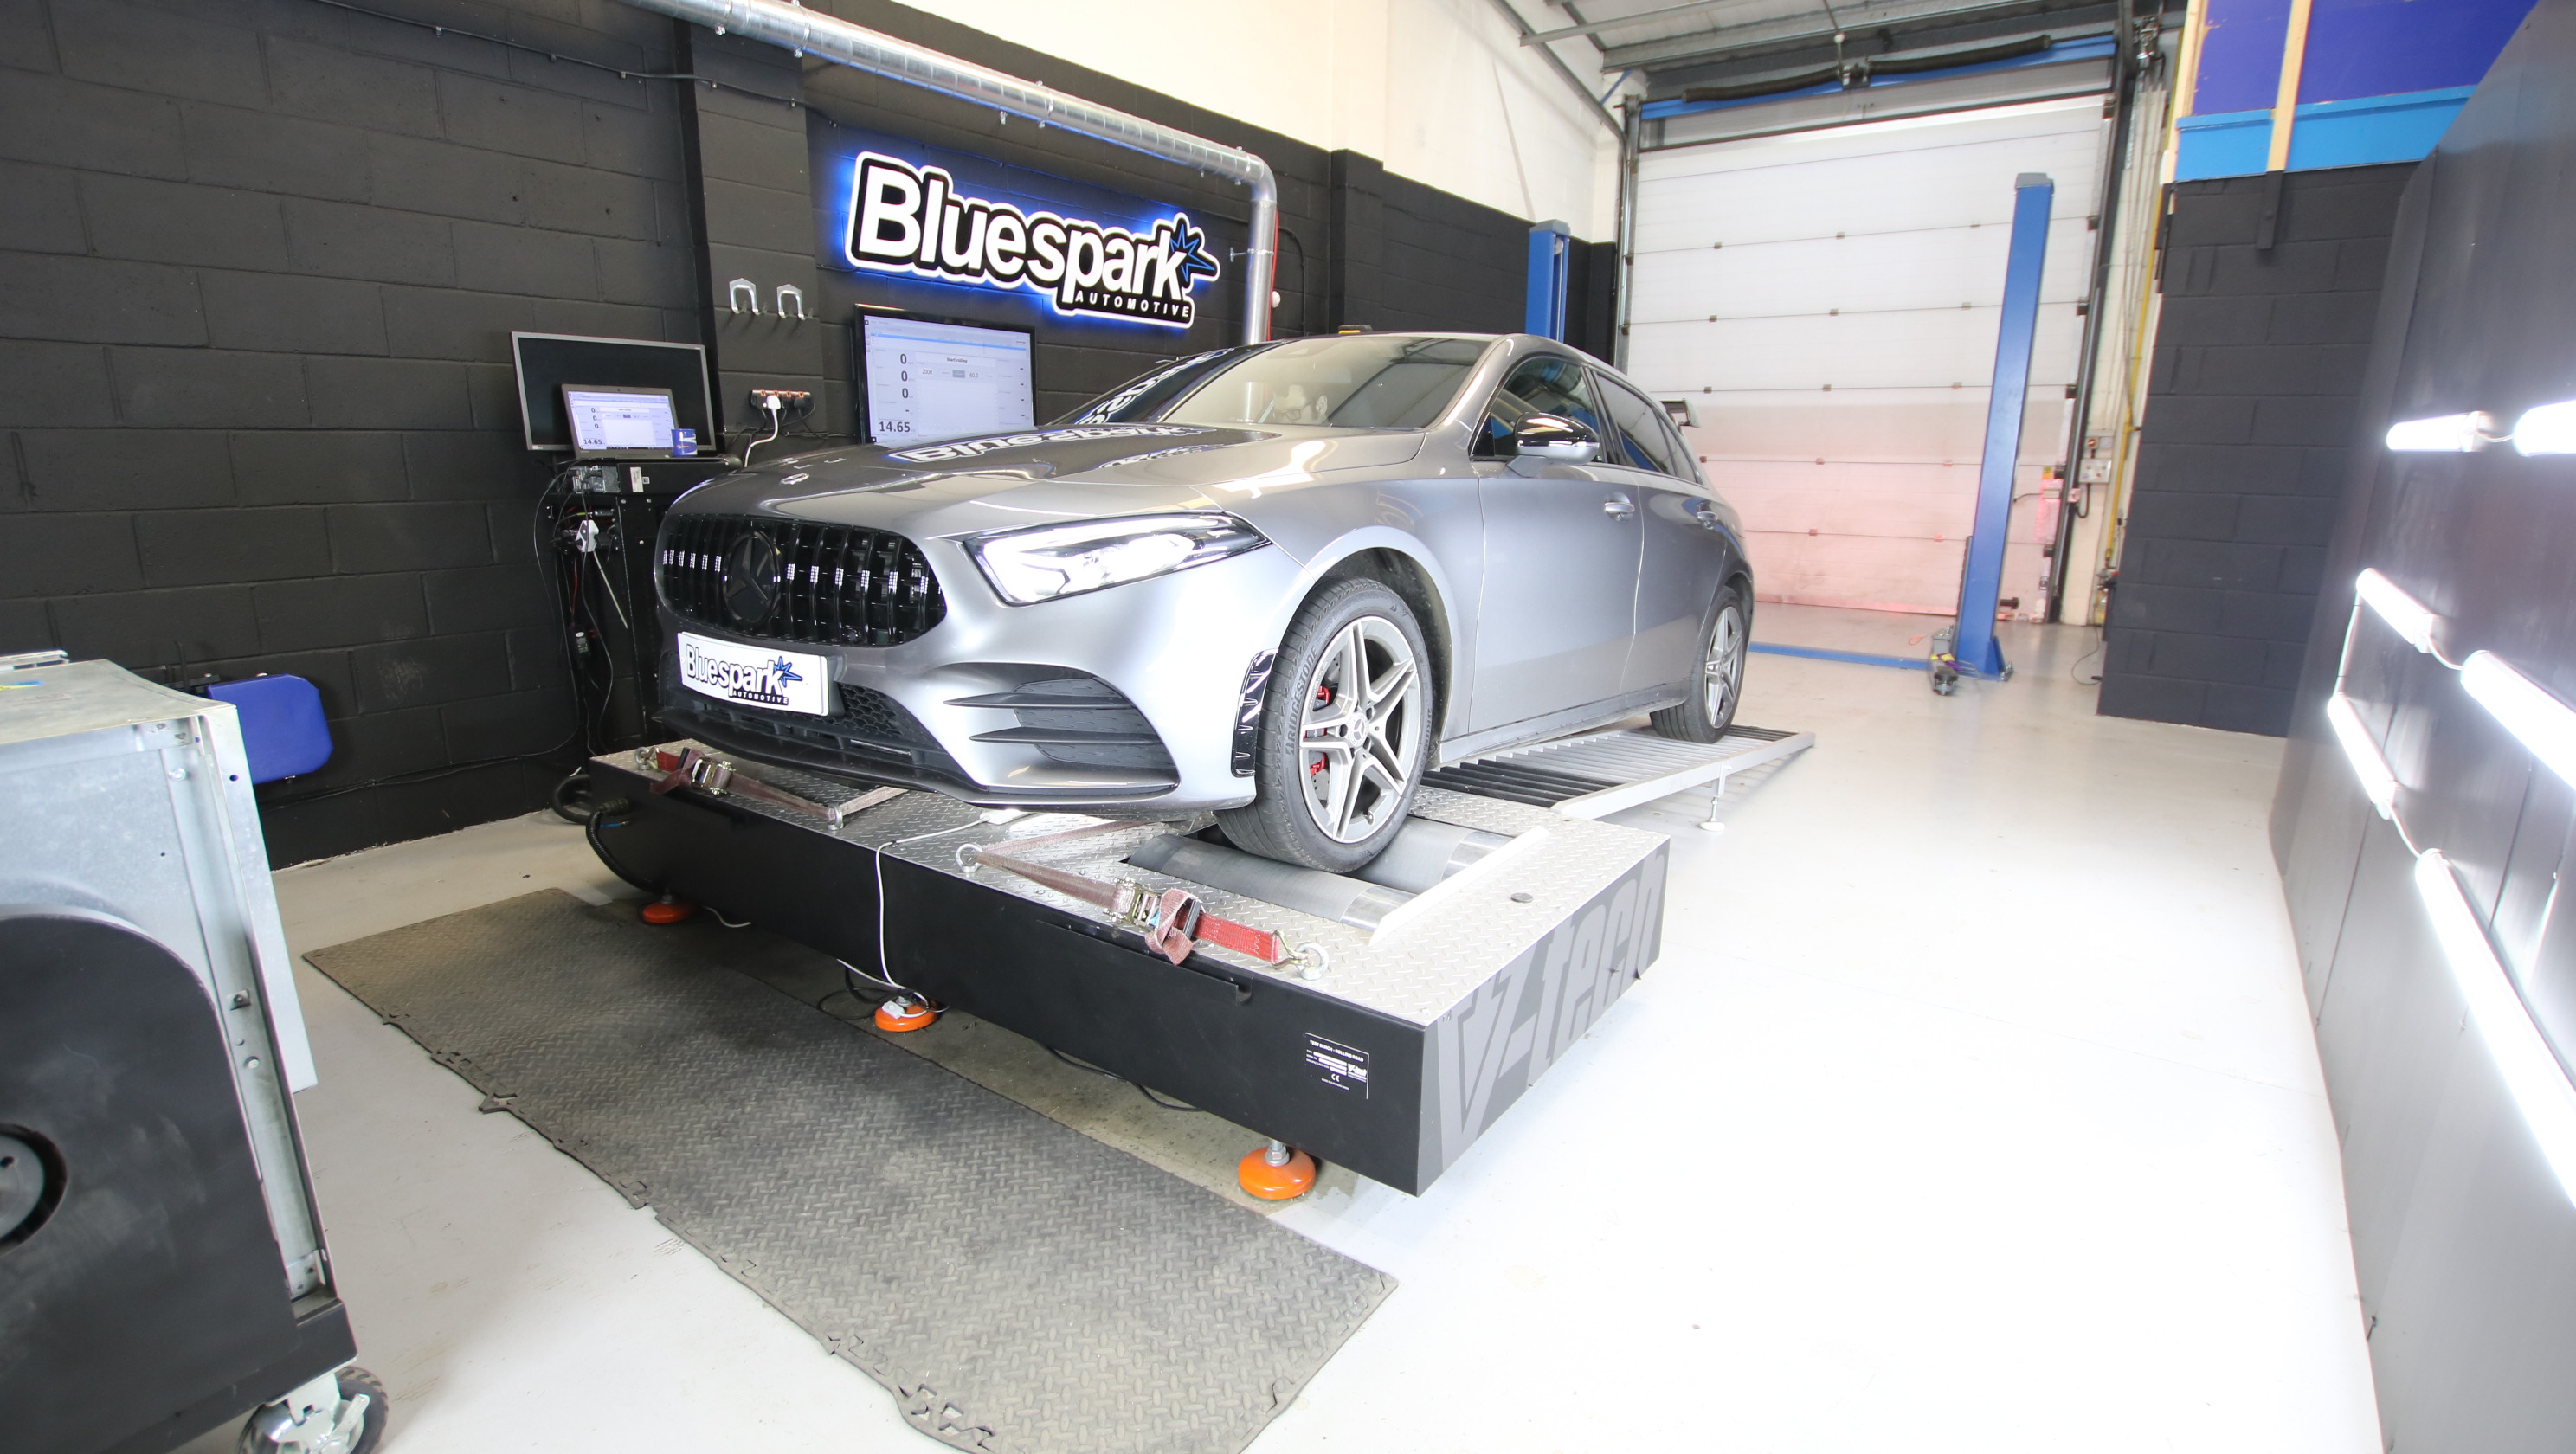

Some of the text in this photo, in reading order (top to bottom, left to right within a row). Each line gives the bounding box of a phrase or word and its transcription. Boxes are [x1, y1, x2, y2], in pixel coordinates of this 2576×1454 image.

[859, 164, 1188, 303] Bluespark
[1075, 289, 1190, 318] AUTOMOTIVE
[900, 353, 907, 364] 0
[901, 370, 908, 382] 0
[902, 388, 909, 398] 0
[879, 421, 911, 433] 14.65
[686, 643, 784, 698] Bluespark
[732, 691, 789, 704] AUTOMOTIVE
[1285, 646, 1317, 756] BRIDGESTONE
